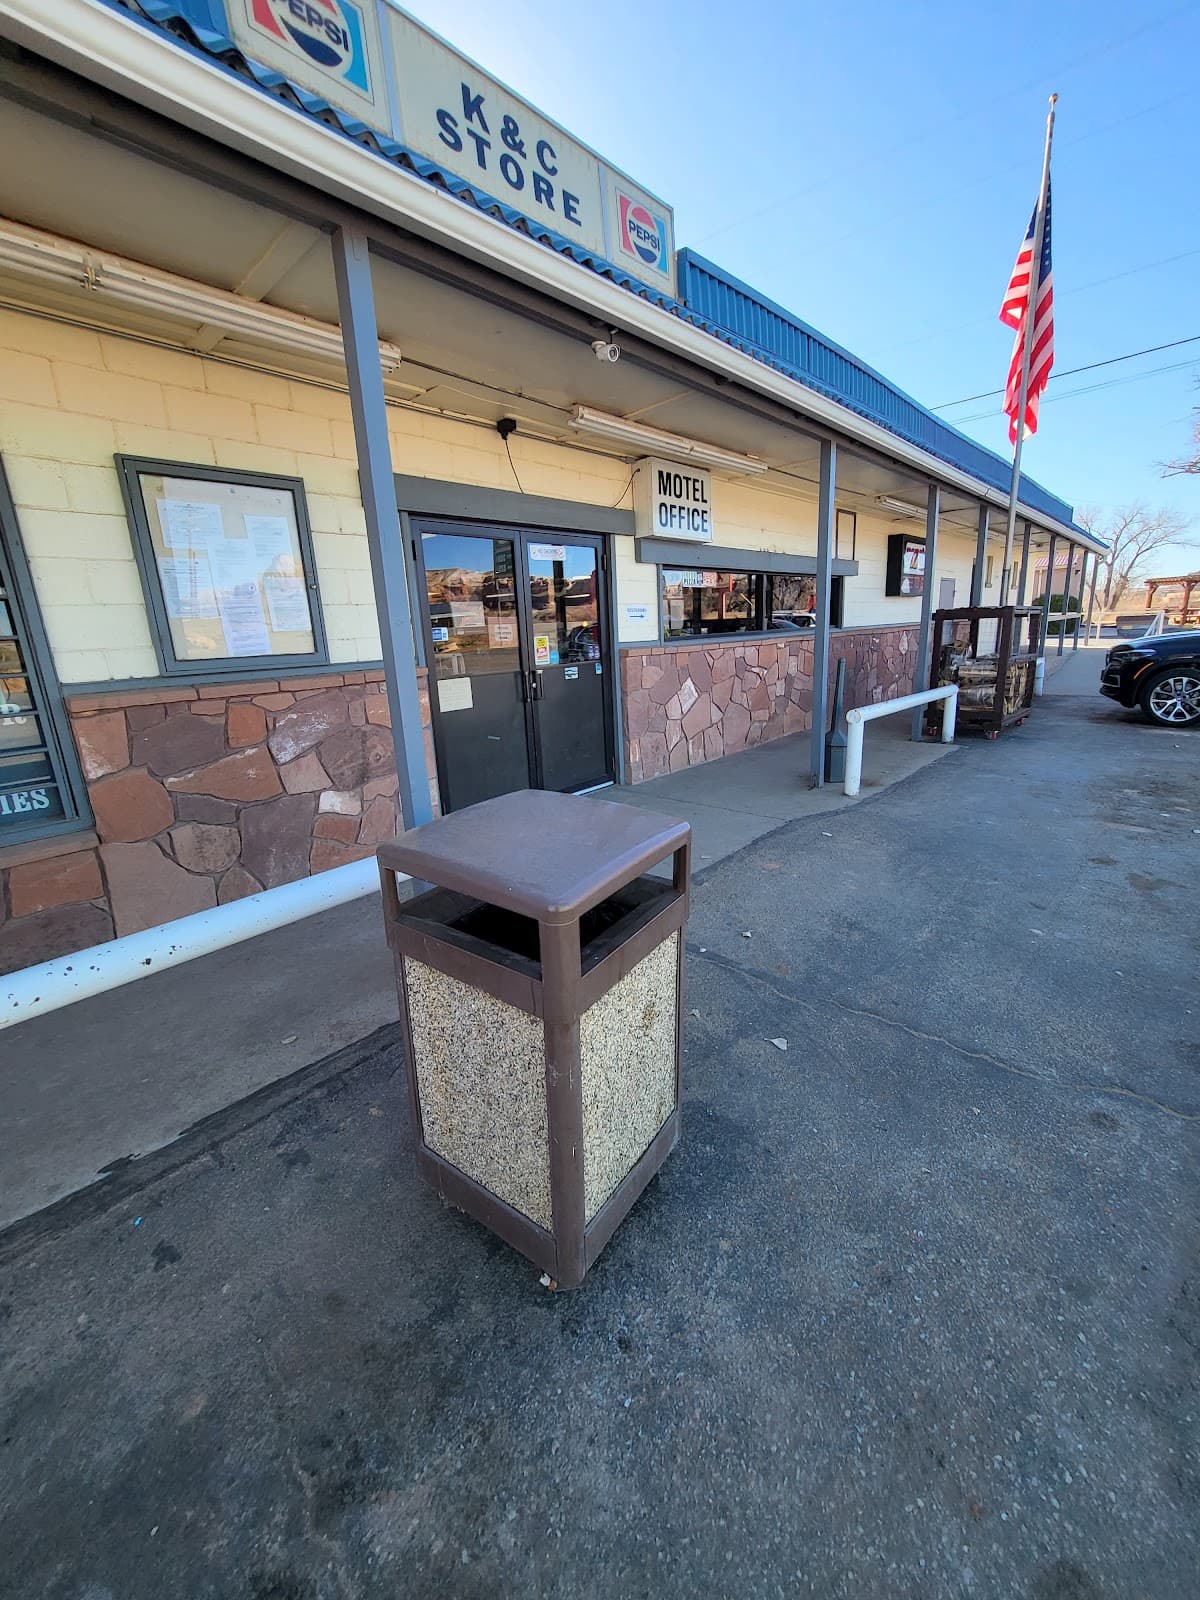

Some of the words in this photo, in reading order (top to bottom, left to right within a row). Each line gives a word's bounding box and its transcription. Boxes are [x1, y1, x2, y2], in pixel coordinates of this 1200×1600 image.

[272, 0, 349, 52] EPSI
[461, 82, 491, 136] K
[500, 114, 527, 160] &
[536, 139, 558, 177] C
[436, 108, 582, 227] STORE
[628, 218, 661, 252] PEPSI
[658, 469, 708, 504] MOTEL
[659, 502, 708, 533] OFFICE
